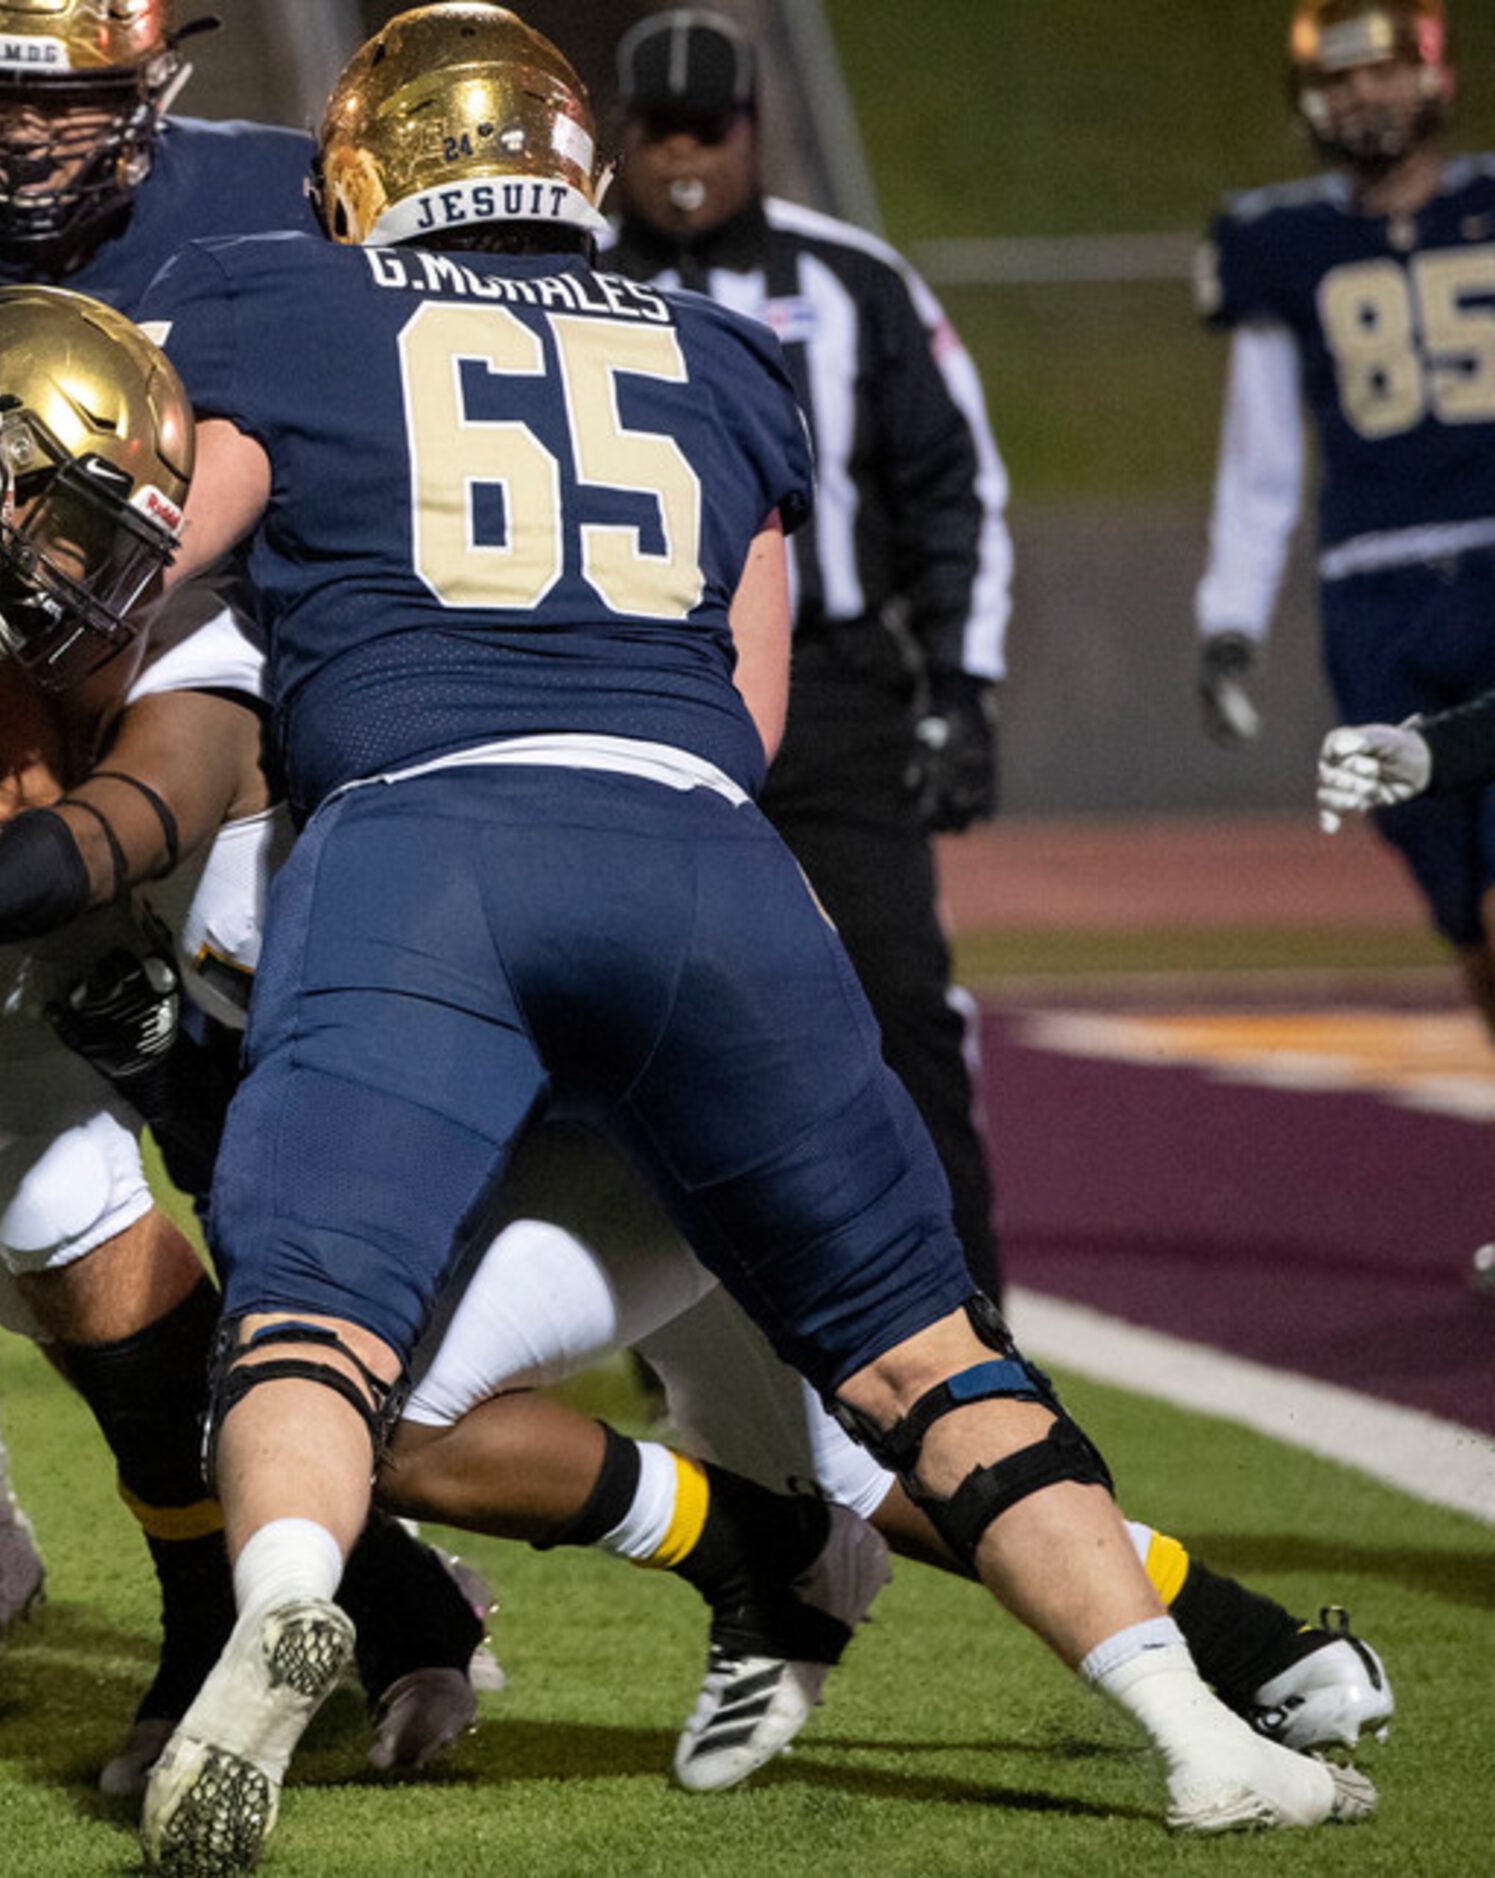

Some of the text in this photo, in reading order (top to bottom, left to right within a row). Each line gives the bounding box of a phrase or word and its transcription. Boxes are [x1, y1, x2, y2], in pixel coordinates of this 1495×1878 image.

[416, 183, 568, 229] JESUIT
[442, 132, 473, 161] 24
[1315, 242, 1495, 441] 85
[397, 299, 706, 620] 65
